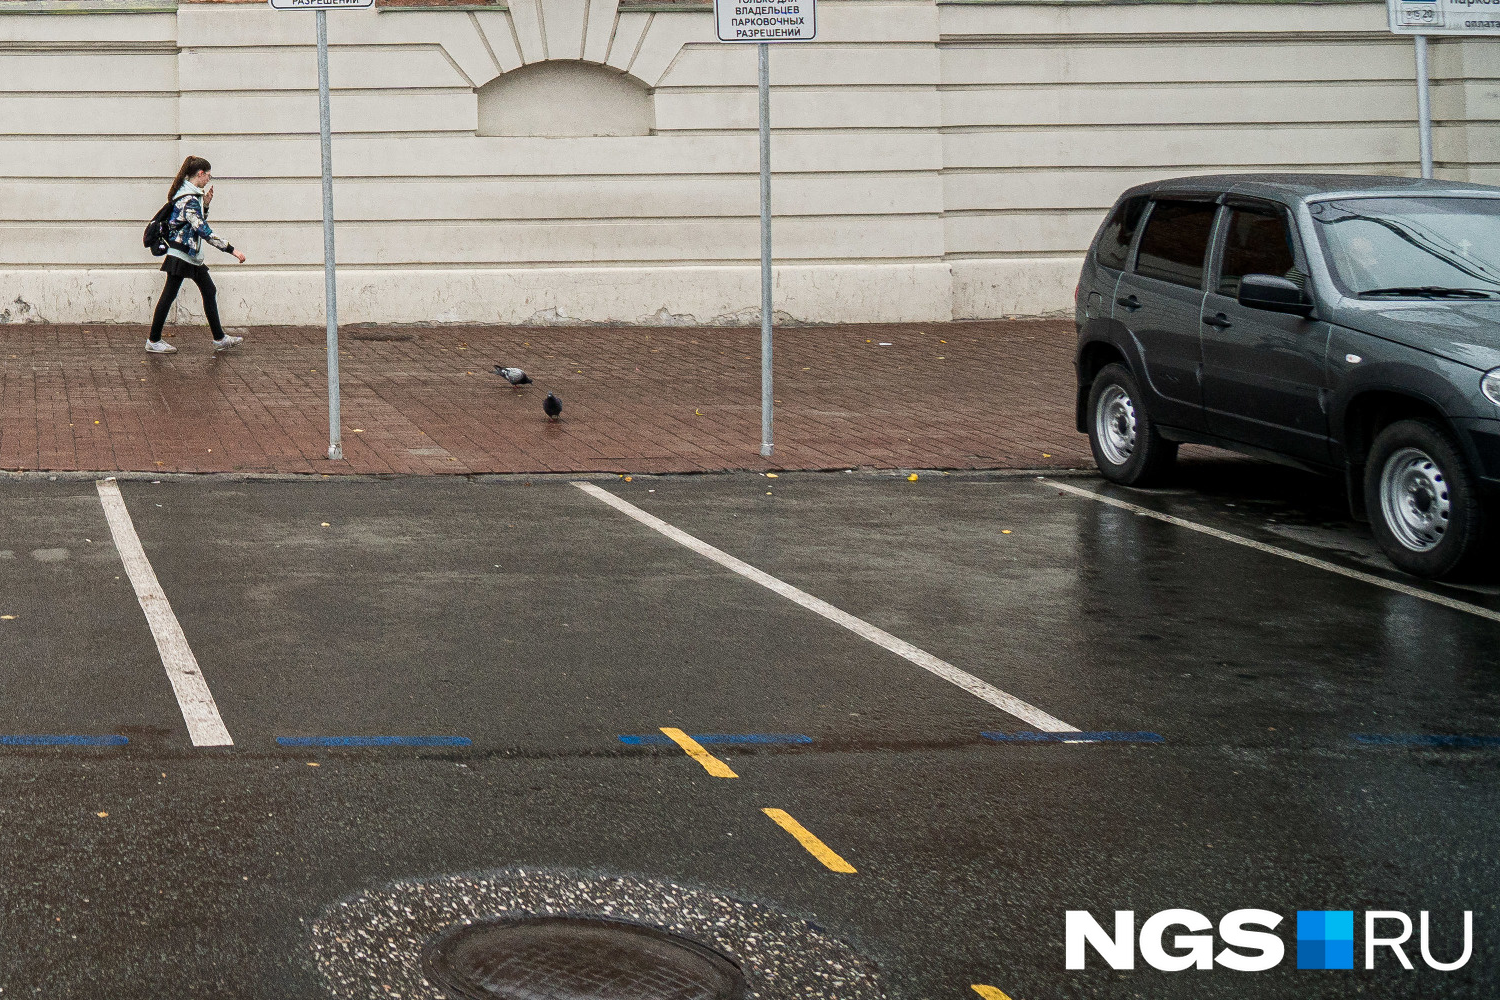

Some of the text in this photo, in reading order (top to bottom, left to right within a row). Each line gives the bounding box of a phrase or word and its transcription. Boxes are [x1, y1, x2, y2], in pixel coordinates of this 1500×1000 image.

[735, 6, 799, 15] ВЛАДЕЛЬЦЕВ
[731, 17, 804, 26] ПАРКОВОЧНЫХ
[736, 27, 801, 37] РАЗРЕШЕНИЙ
